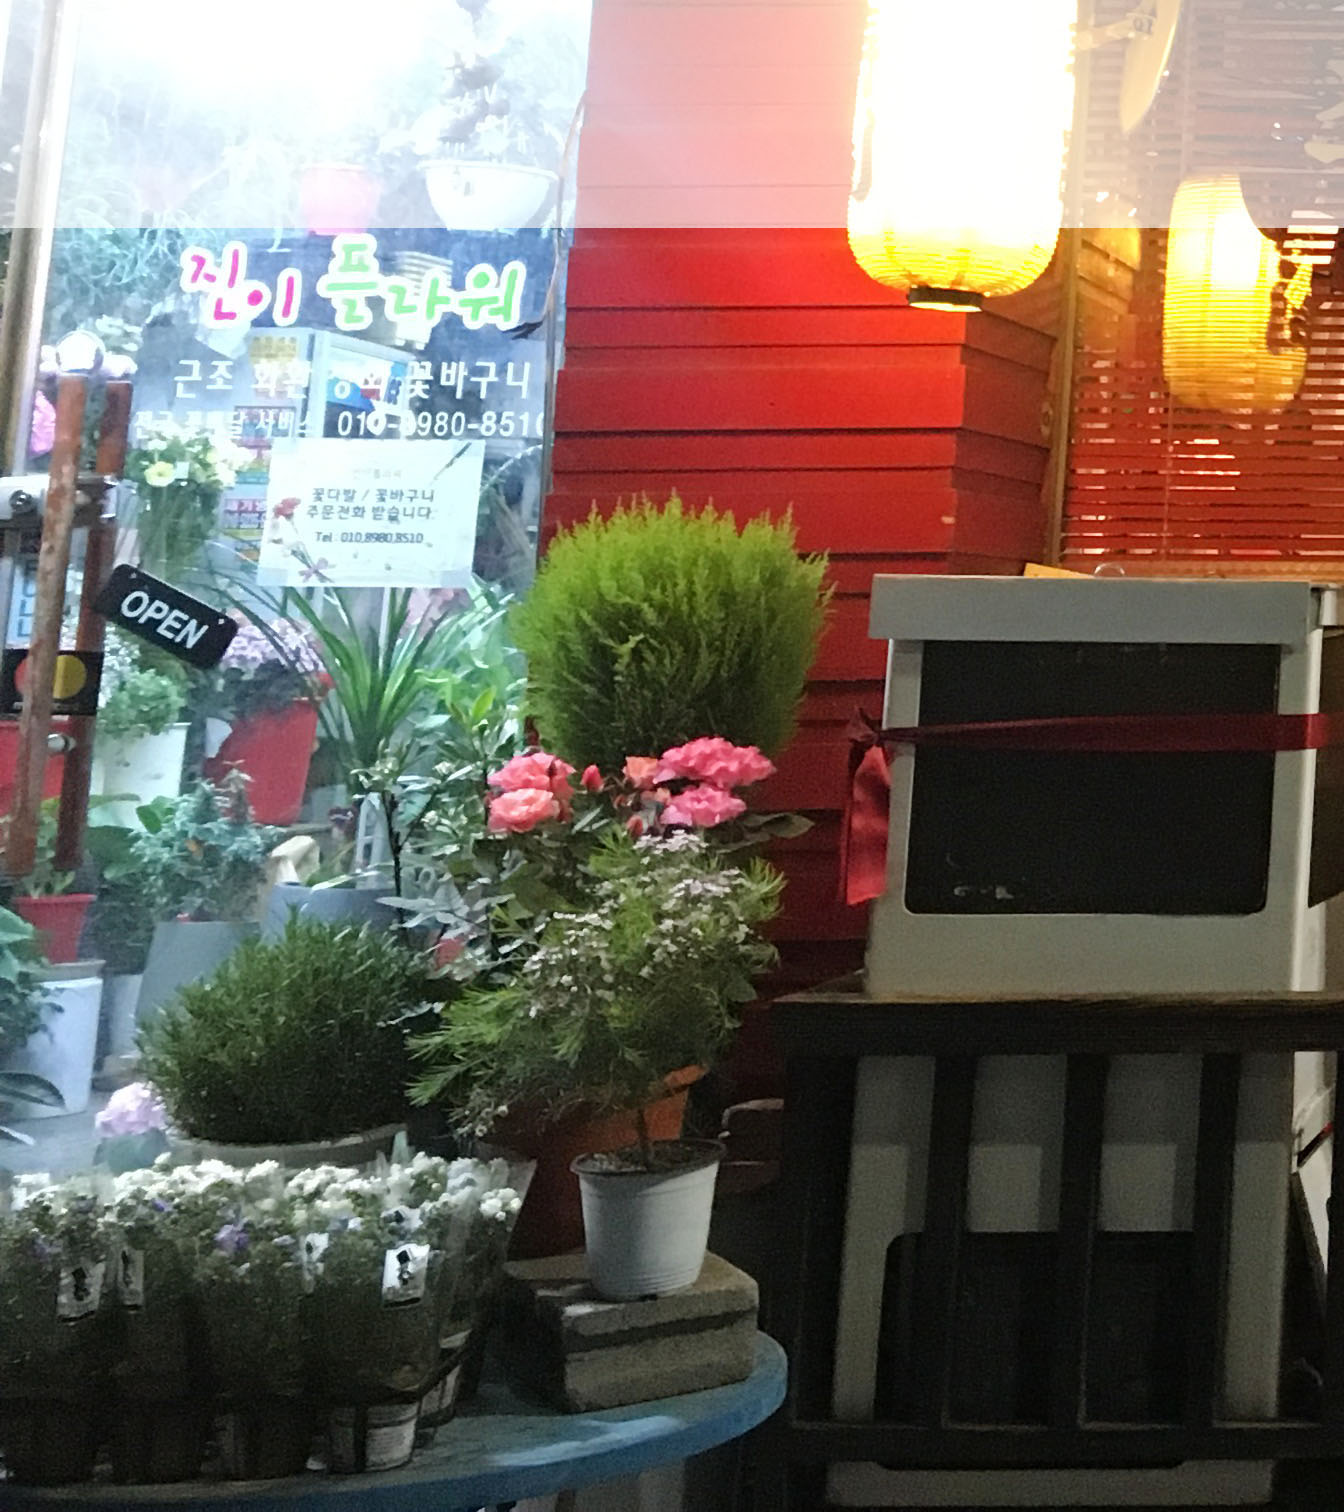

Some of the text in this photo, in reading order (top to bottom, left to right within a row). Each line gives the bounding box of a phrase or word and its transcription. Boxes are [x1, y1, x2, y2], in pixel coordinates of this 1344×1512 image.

[186, 238, 523, 326] 진이 플라워
[173, 359, 234, 399] 근조
[407, 360, 531, 400] 꽃바구니
[338, 410, 544, 437] 010-980-8510
[312, 488, 357, 502] 꽃다발
[375, 489, 435, 503] 꽃바구니
[306, 506, 366, 520] 주문전화
[120, 590, 210, 649] OPEN
